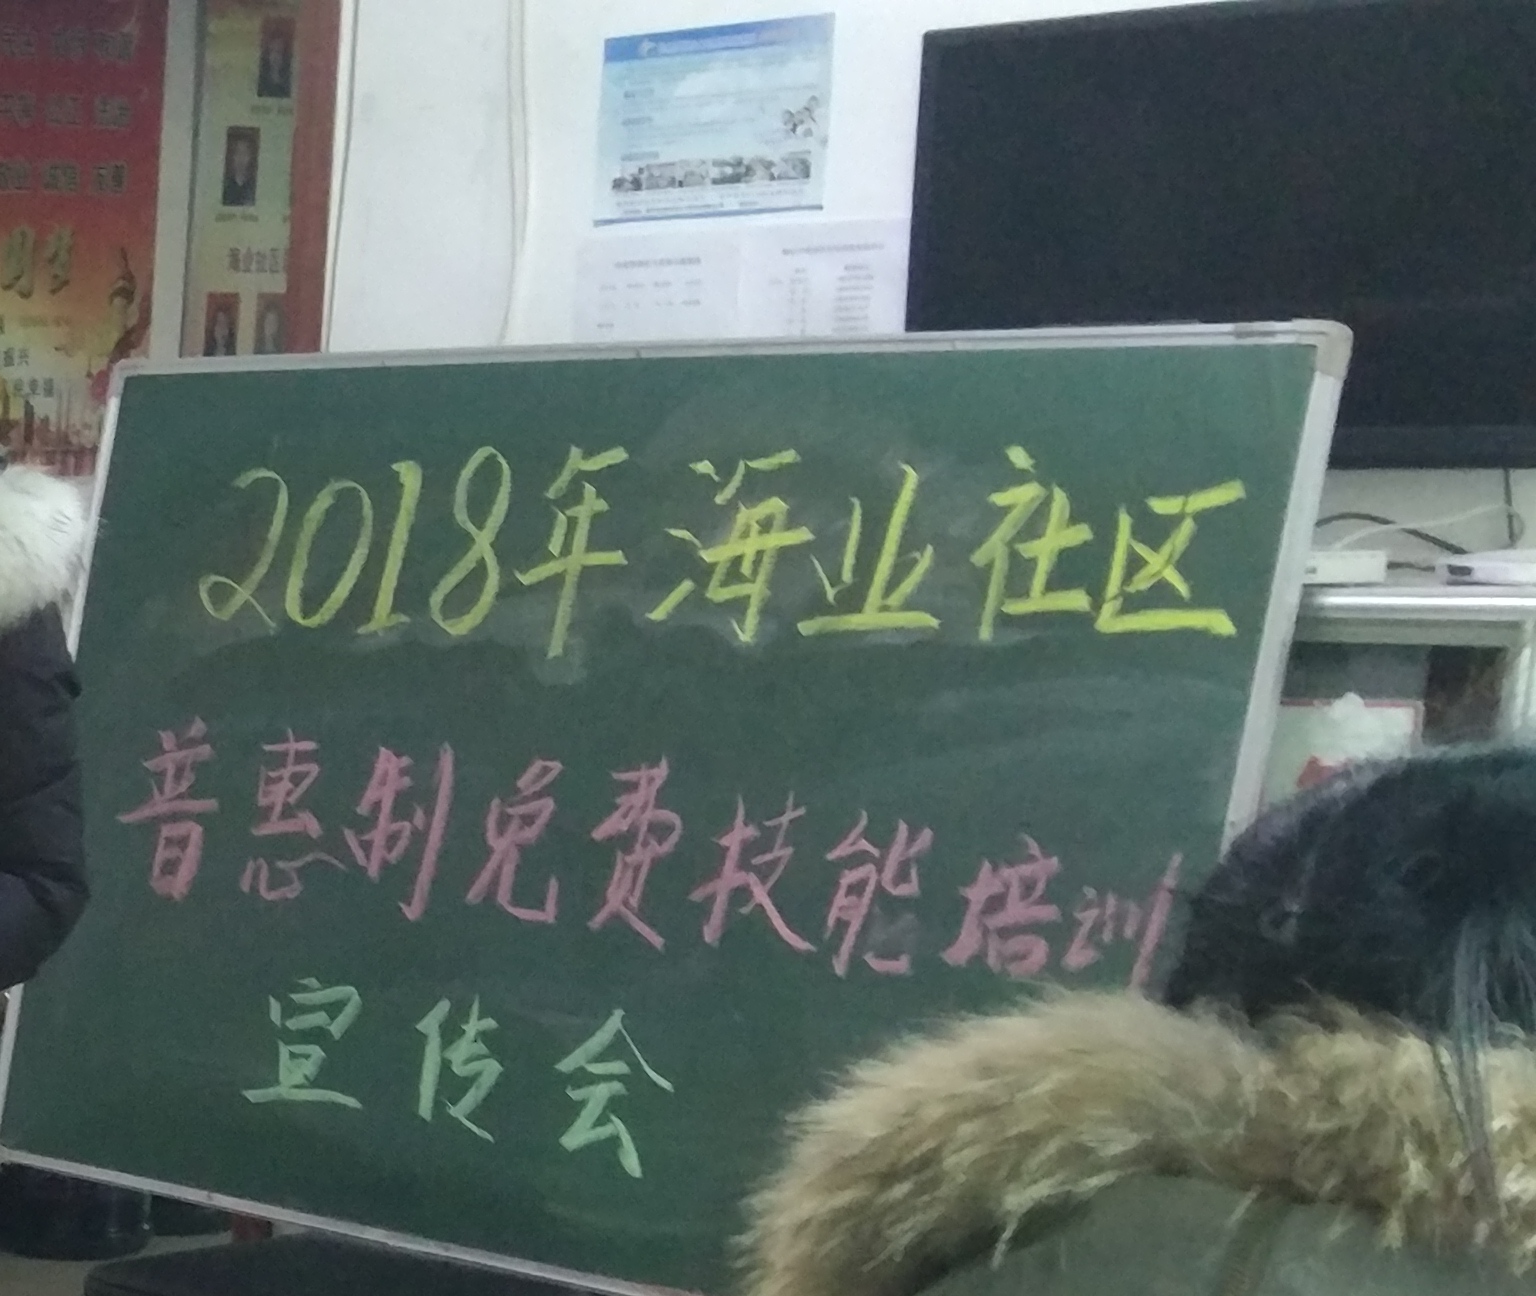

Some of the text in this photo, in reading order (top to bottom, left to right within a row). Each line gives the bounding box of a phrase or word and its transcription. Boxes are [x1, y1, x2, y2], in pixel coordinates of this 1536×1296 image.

[199, 444, 1246, 658] 2018年海业社区
[120, 716, 1185, 988] 普惠制免费技能培训
[241, 977, 674, 1178] 宣传会
